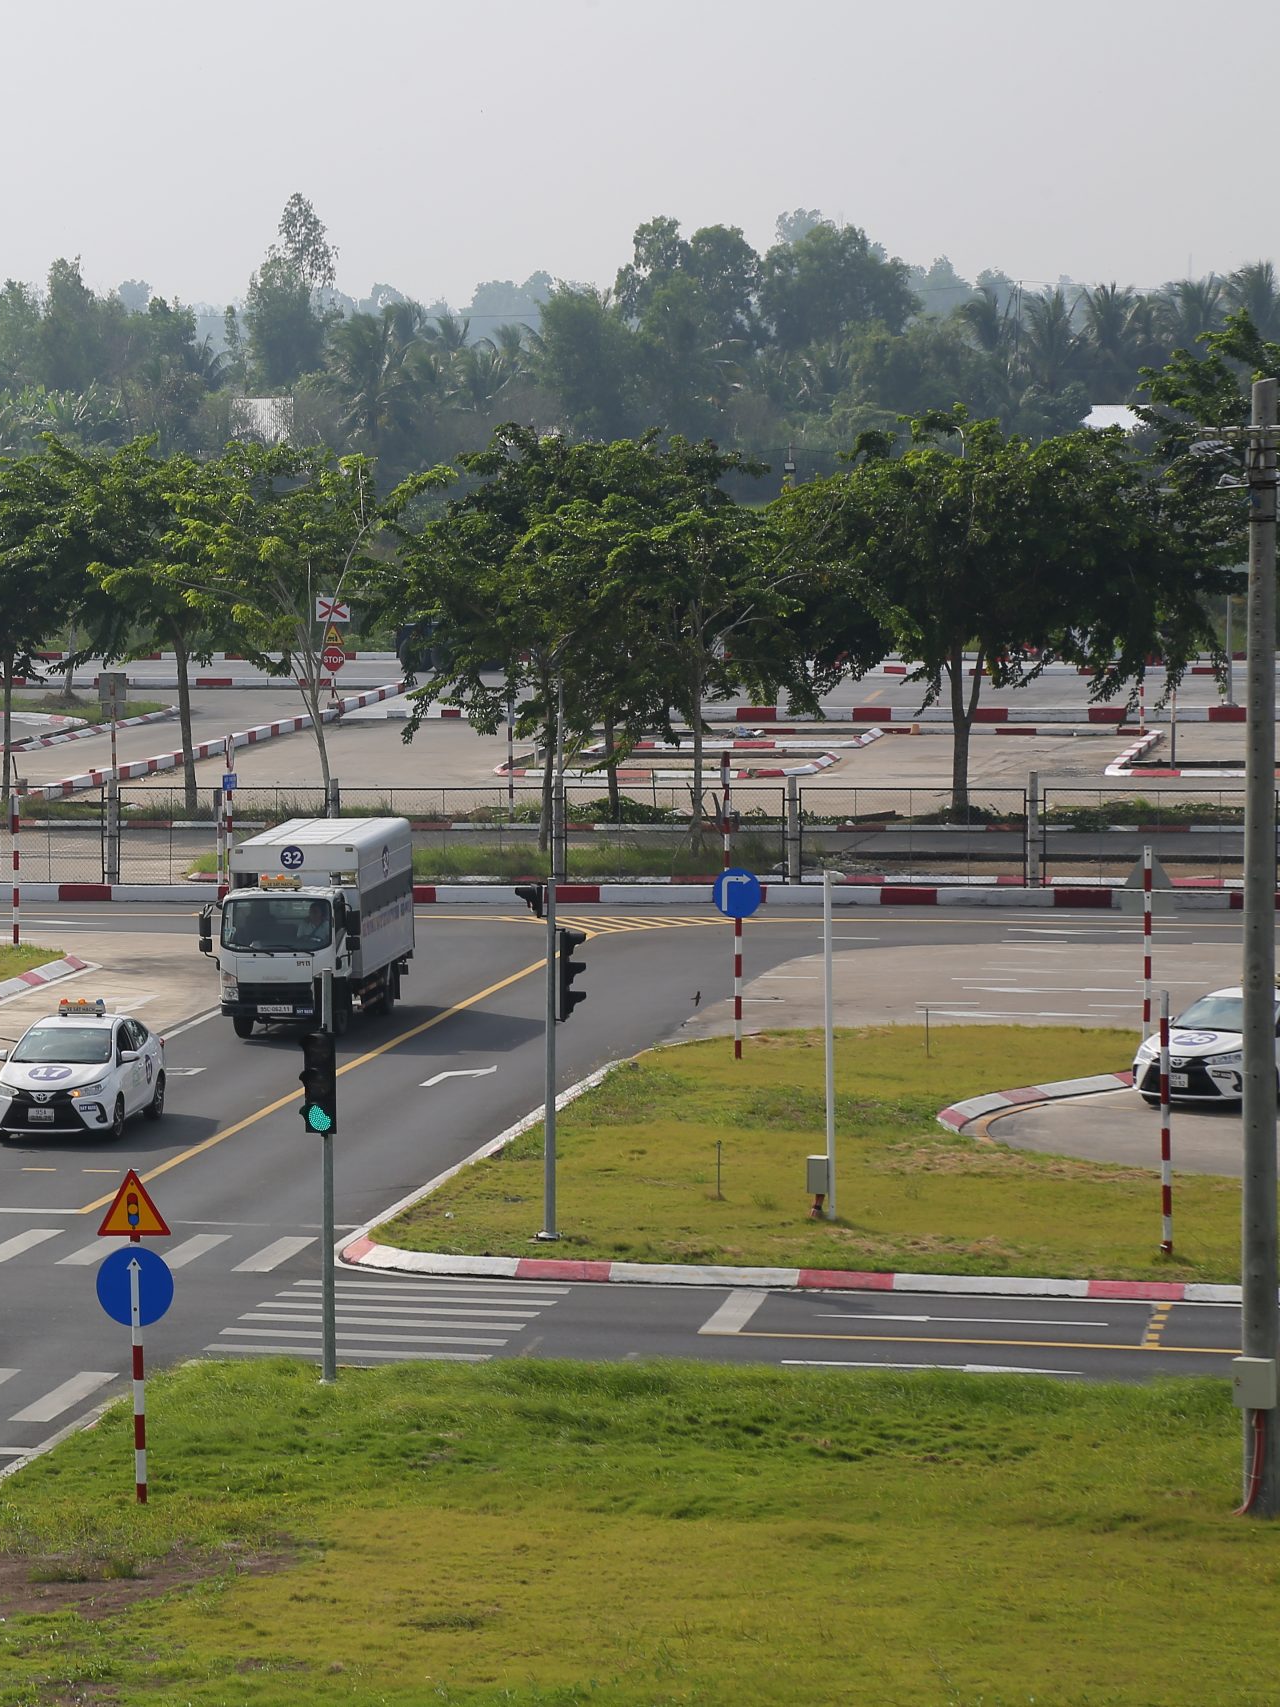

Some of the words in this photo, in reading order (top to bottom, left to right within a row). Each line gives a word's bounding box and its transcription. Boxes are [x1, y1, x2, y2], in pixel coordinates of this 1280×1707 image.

[324, 656, 344, 664] STOP
[283, 851, 301, 864] 32
[1173, 1033, 1216, 1044] 26
[32, 1067, 69, 1078] 17
